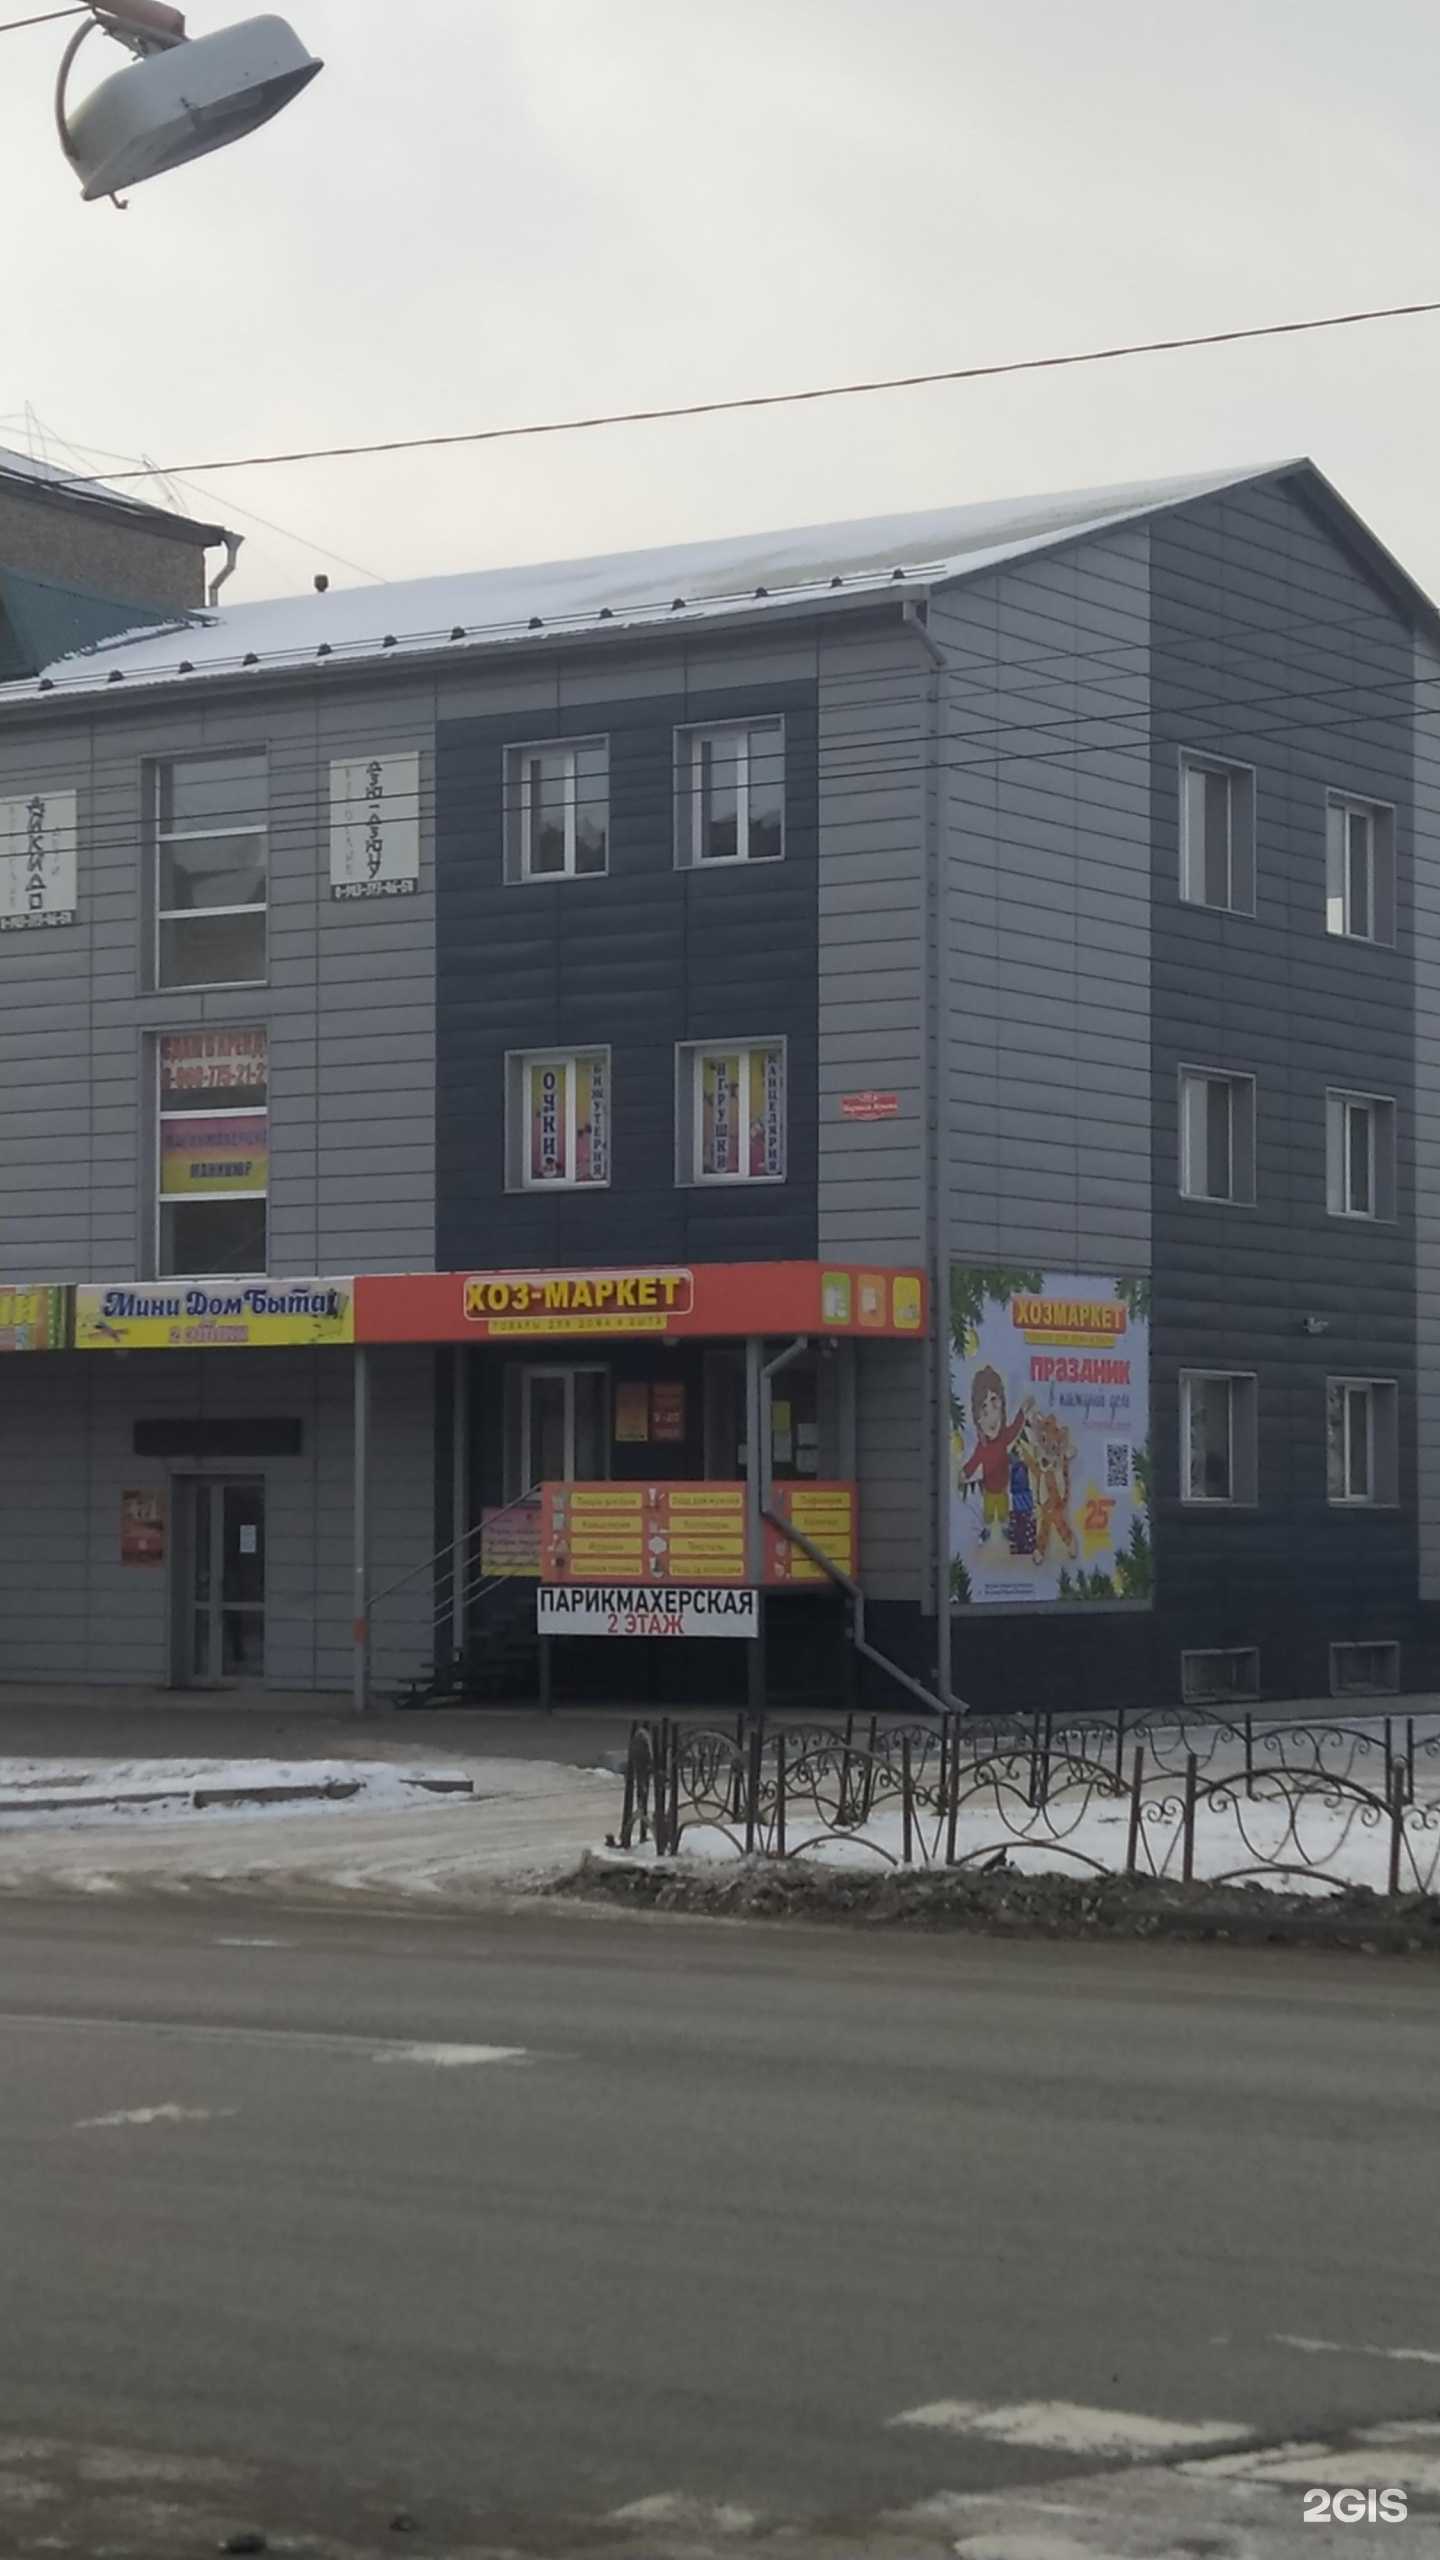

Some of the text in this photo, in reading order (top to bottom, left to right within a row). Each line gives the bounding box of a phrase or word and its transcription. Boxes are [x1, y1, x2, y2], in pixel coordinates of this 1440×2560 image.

[543, 1072, 556, 1155] ОЧКИ
[715, 1063, 728, 1169] ИГРУШКИ
[104, 1292, 180, 1318] Мини
[466, 1276, 681, 1311] ХОЗ-МАРКЕТ
[1016, 1300, 1121, 1329] ХОЗМАРКЕТ
[540, 1588, 754, 1615] ПАРИКМАХЕРСКАЯ
[607, 1613, 684, 1635] 2 ЭТАЖ
